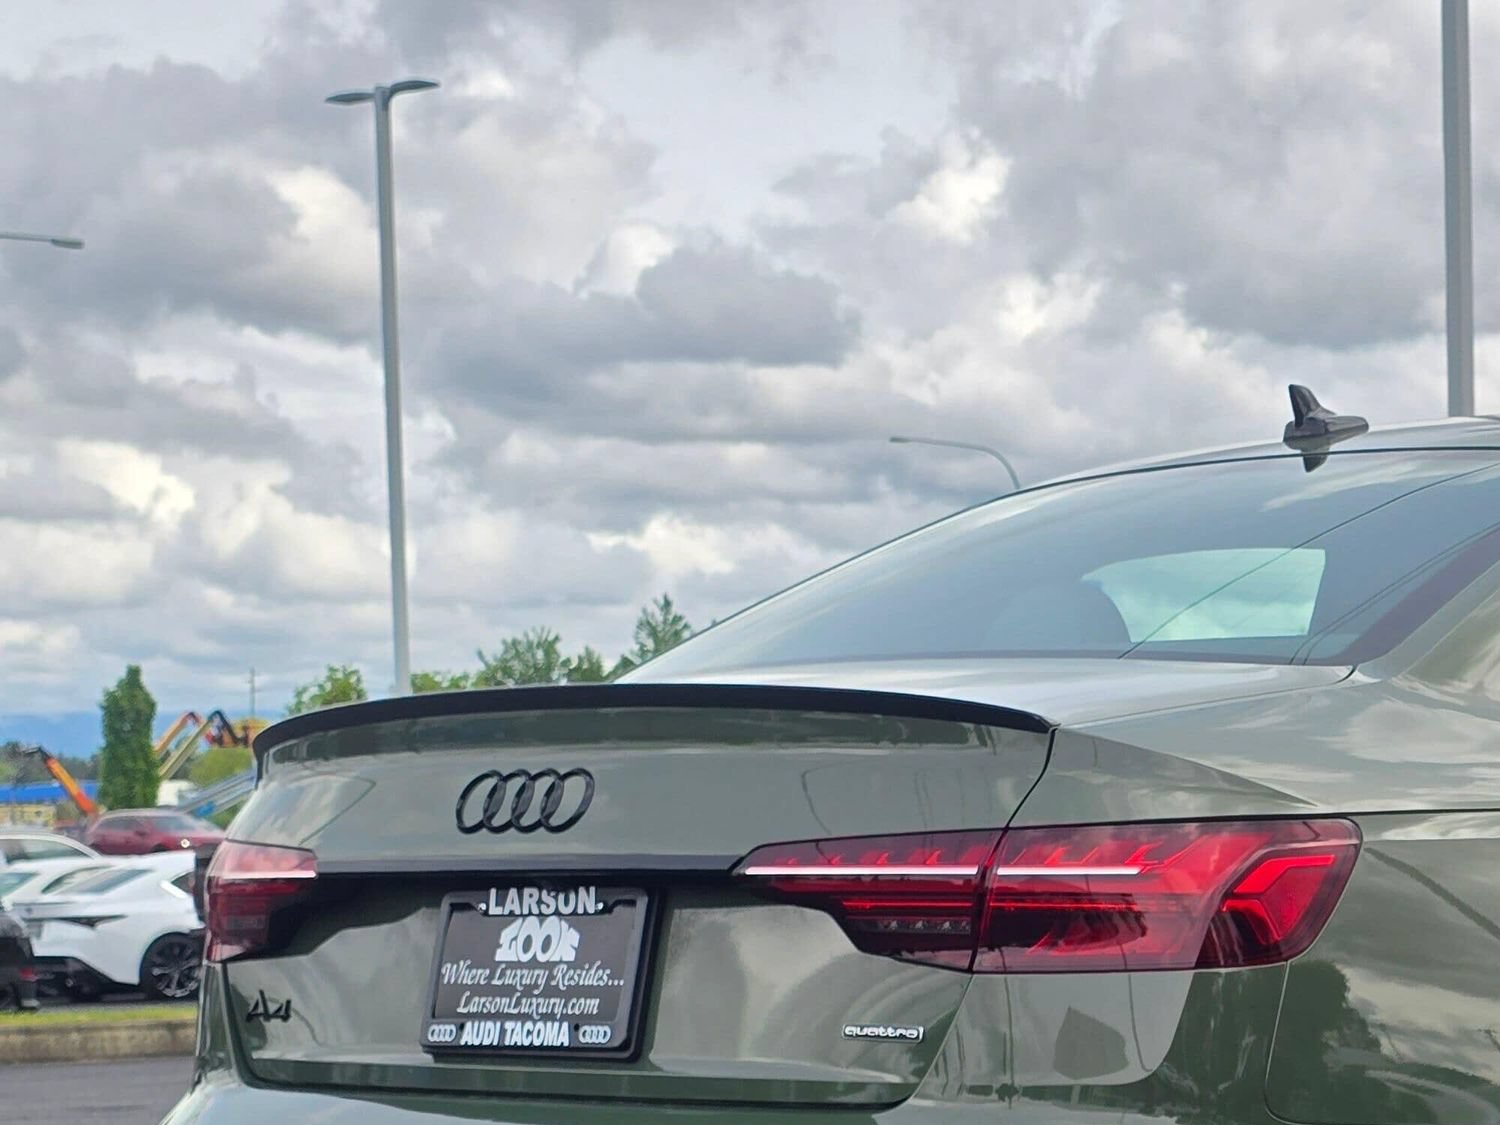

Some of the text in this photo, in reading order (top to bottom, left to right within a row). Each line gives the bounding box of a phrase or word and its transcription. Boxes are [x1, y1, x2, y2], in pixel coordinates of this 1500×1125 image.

[488, 886, 596, 915] LARSON
[442, 960, 624, 994] Where Luxury Resides...
[247, 989, 291, 1022] A4
[457, 992, 599, 1018] LarsonLuxury.com
[460, 1021, 569, 1047] AUDI TACOMA
[844, 1025, 918, 1039] quattro
